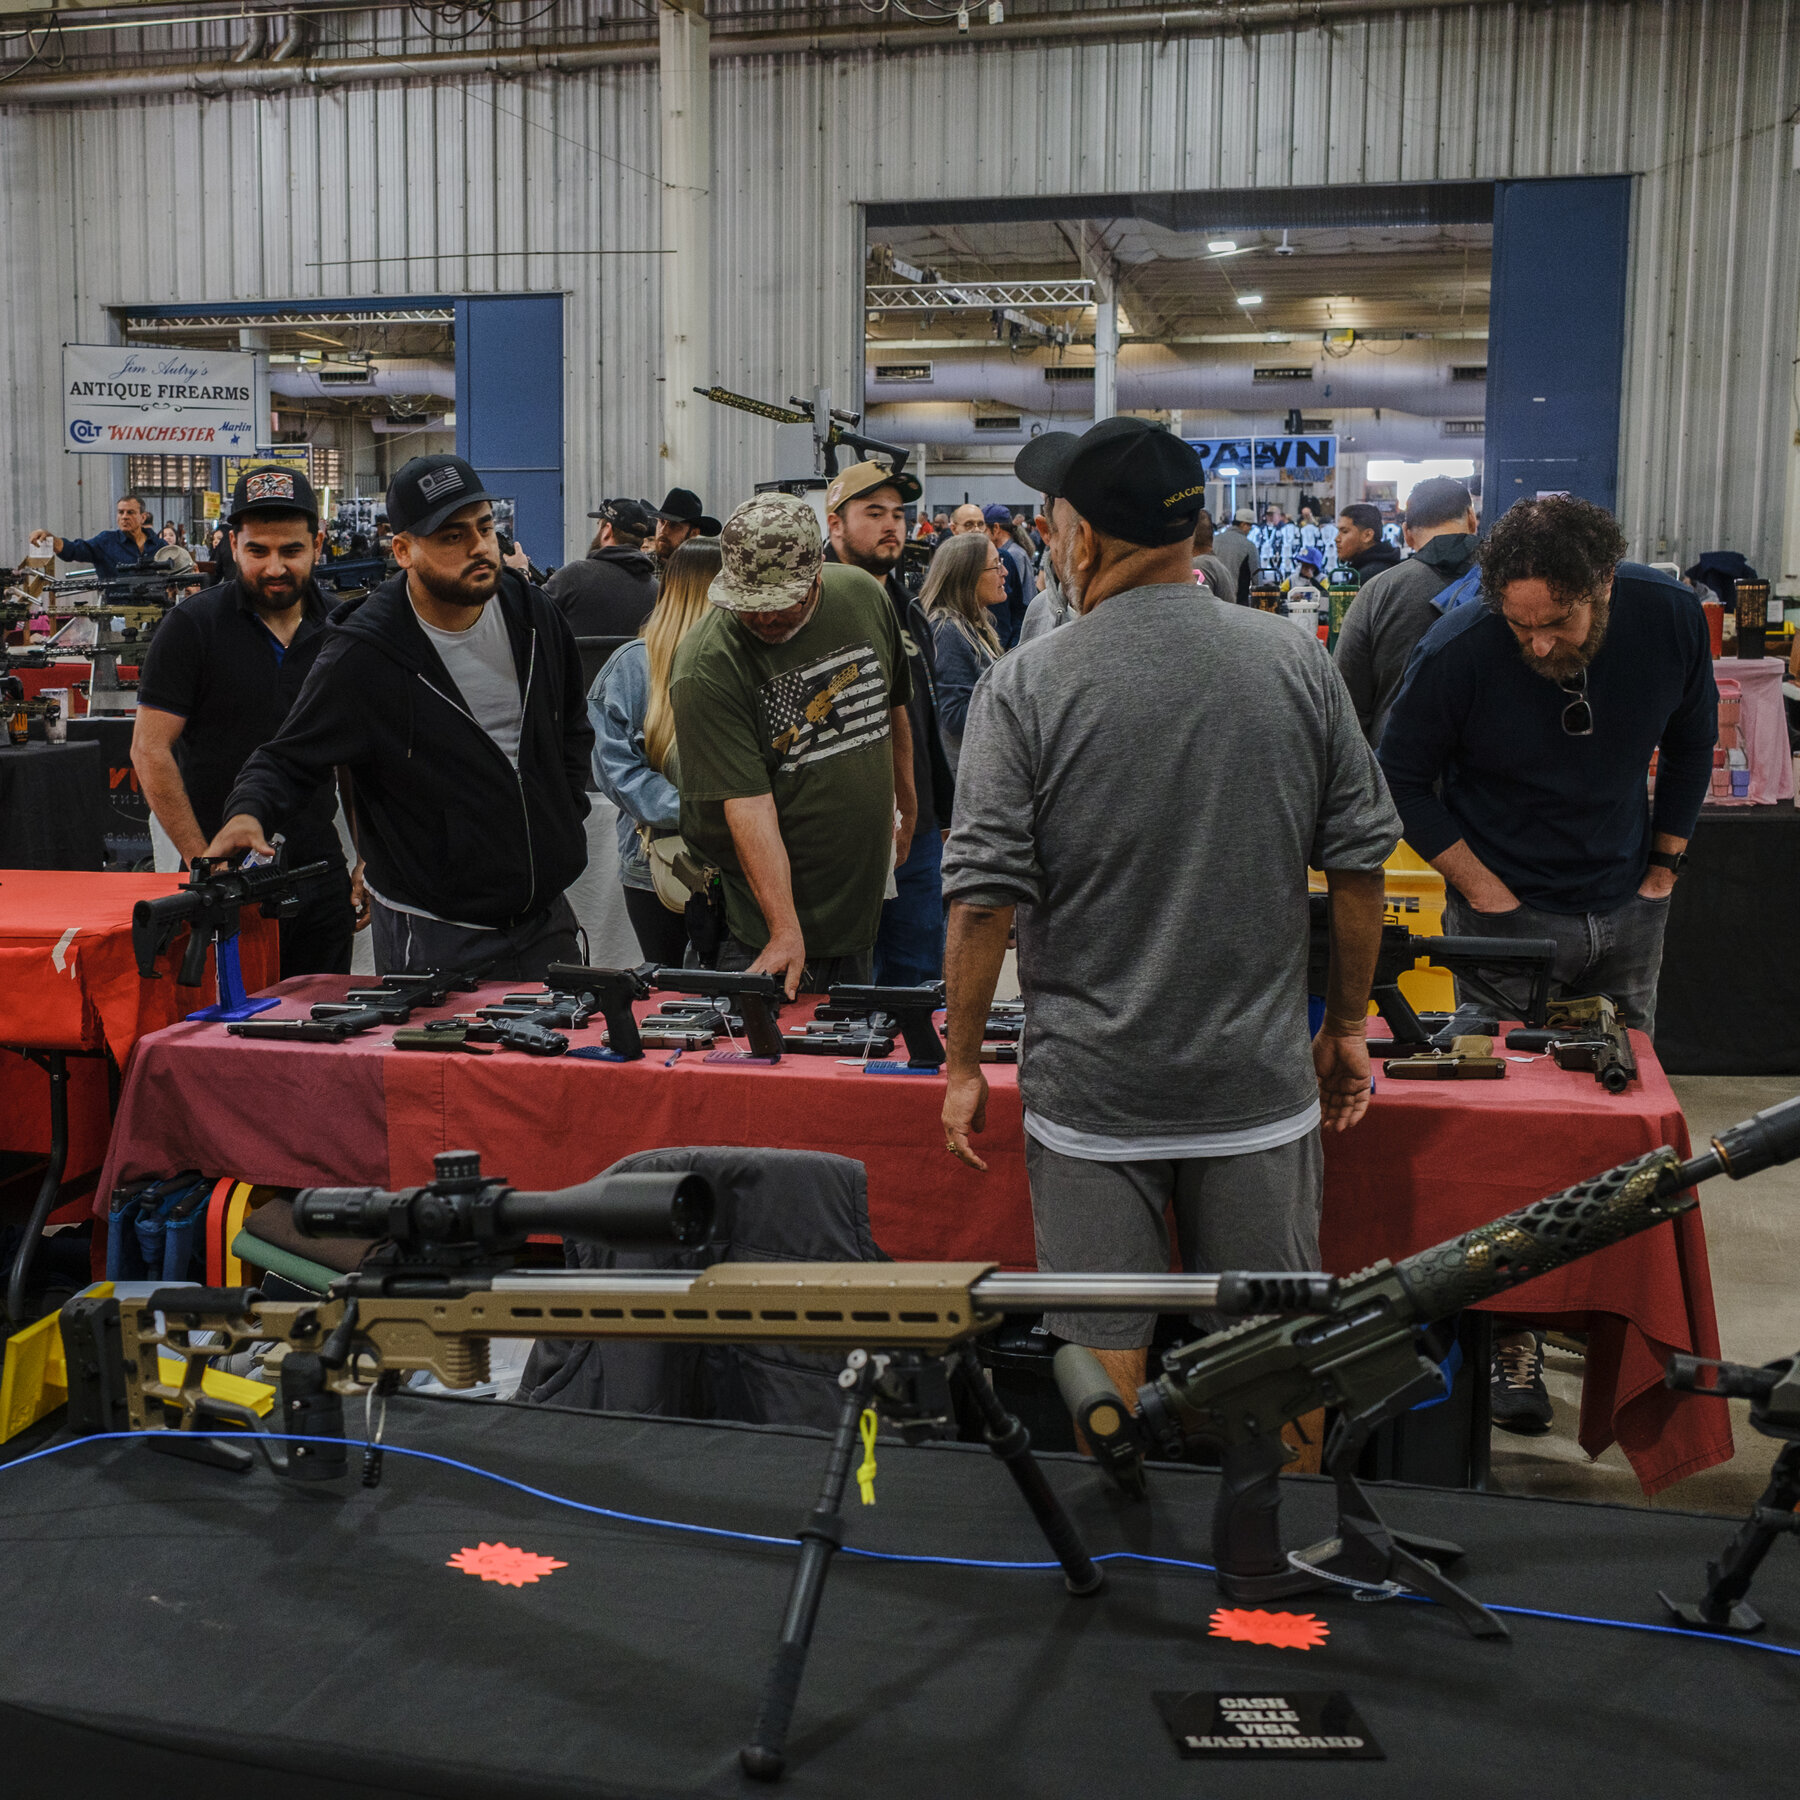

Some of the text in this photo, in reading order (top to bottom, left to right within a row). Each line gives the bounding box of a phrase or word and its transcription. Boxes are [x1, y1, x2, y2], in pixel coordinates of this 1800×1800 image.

[108, 354, 208, 383] Jim Autry's
[70, 381, 250, 401] ANTIQUE FIREARMS
[70, 419, 252, 444] COLT WINCHESTER Marlin
[1163, 491, 1186, 508] INCA
[1219, 1697, 1289, 1710] CASH
[1221, 1710, 1301, 1723] ZELLE
[1235, 1723, 1301, 1736] VISA
[1185, 1736, 1365, 1749] MASTERCARD
